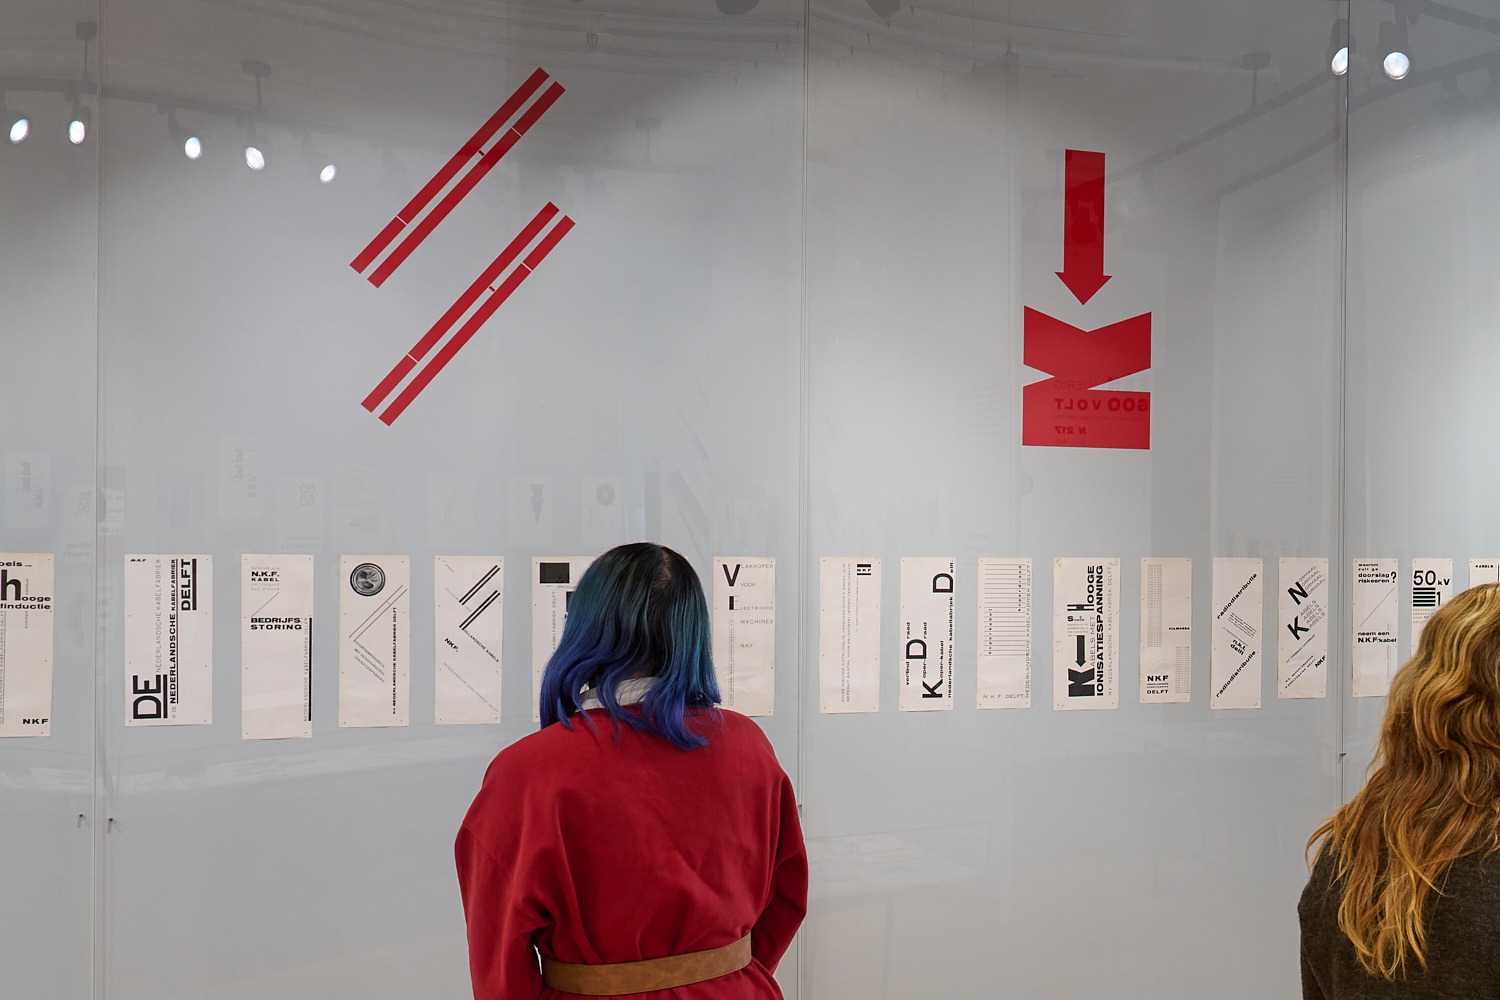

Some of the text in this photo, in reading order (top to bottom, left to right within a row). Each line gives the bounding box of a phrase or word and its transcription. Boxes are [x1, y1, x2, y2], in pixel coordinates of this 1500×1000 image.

[181, 559, 191, 611] DELFT
[1217, 573, 1257, 619] radiodistributie
[1413, 570, 1436, 586] 50
[1096, 565, 1104, 696] IONISATIESPANNING
[1216, 650, 1256, 697] radiodistributie
[1315, 655, 1326, 668] NKF
[133, 675, 161, 719] DE
